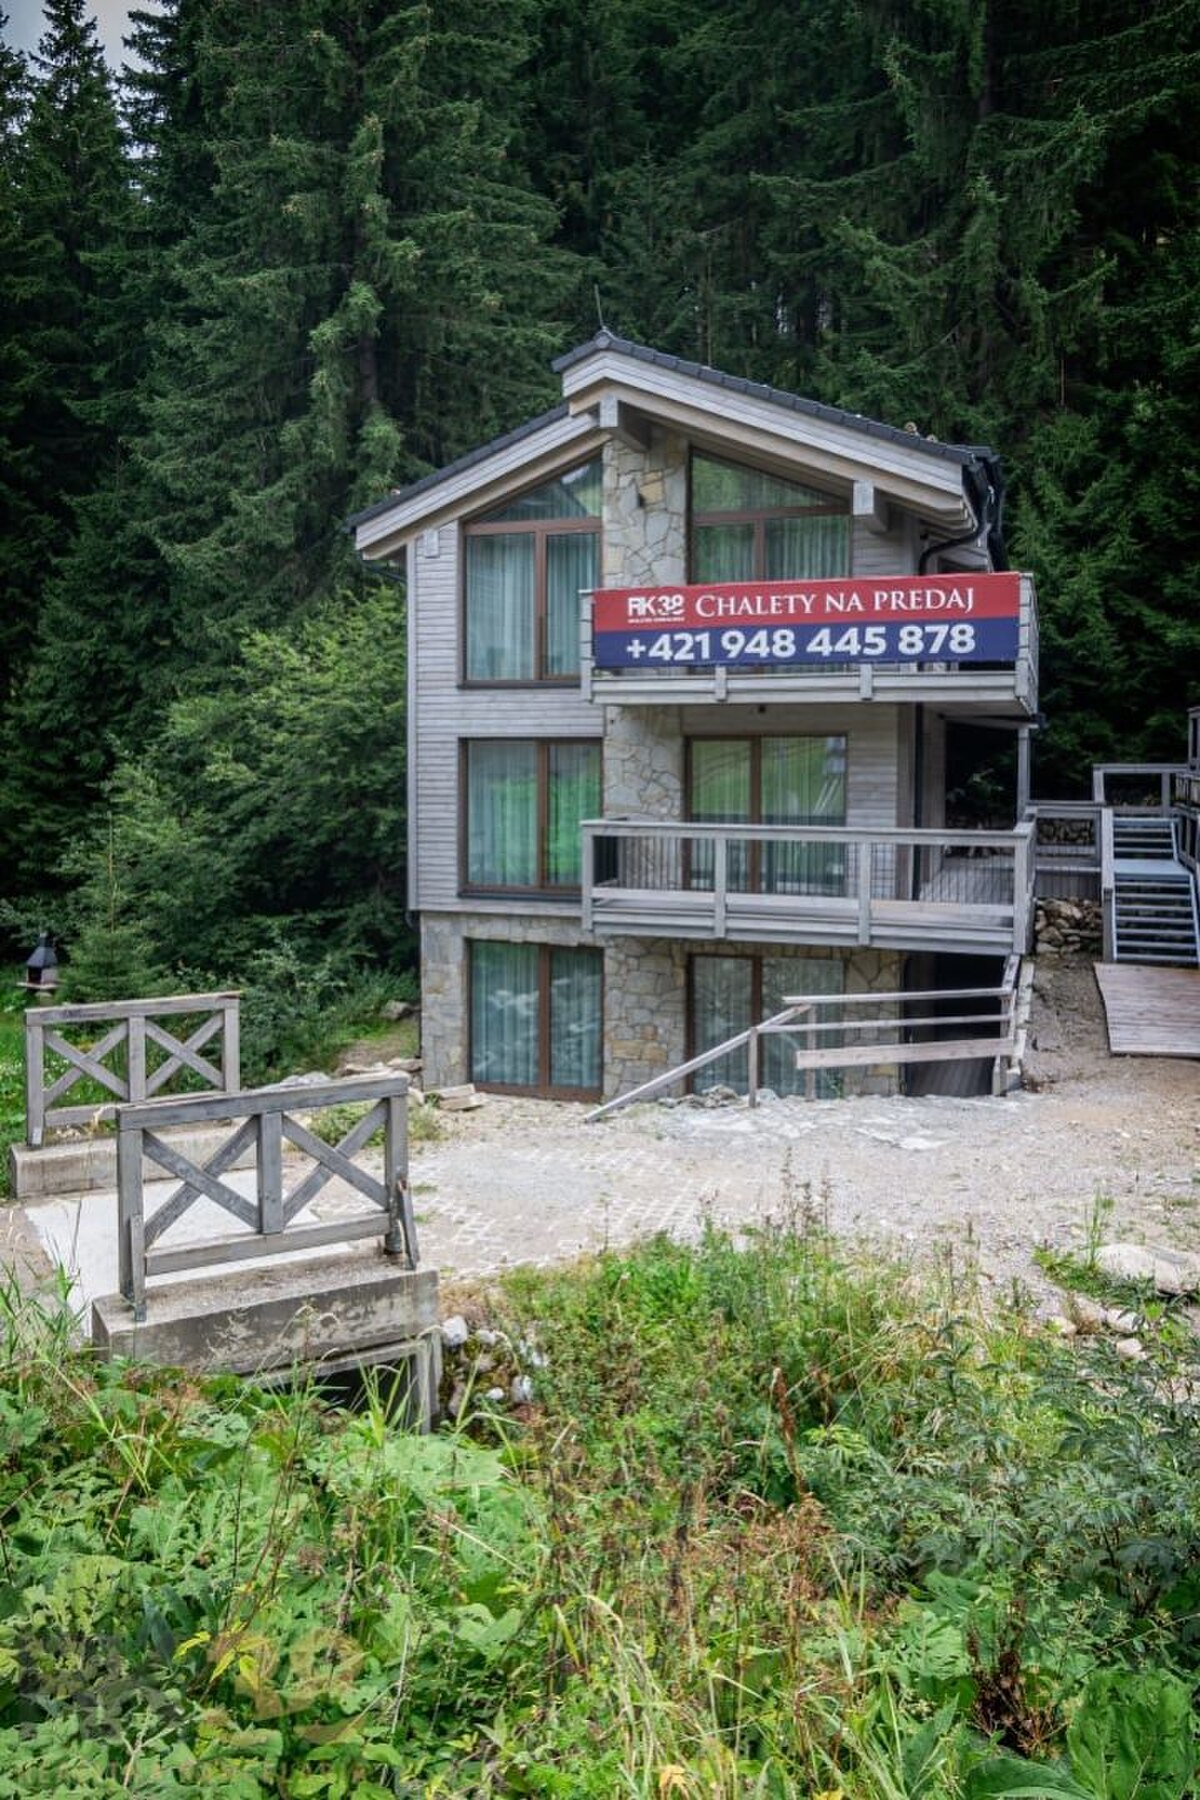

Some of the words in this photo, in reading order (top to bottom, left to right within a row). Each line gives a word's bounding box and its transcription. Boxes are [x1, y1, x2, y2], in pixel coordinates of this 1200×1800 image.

[695, 594, 816, 618] CHALETY
[825, 592, 864, 613] NA
[874, 587, 974, 612] PREDAJ
[626, 631, 710, 661] +421
[720, 628, 797, 659] 948
[806, 626, 887, 657] 445
[898, 623, 976, 655] 878
